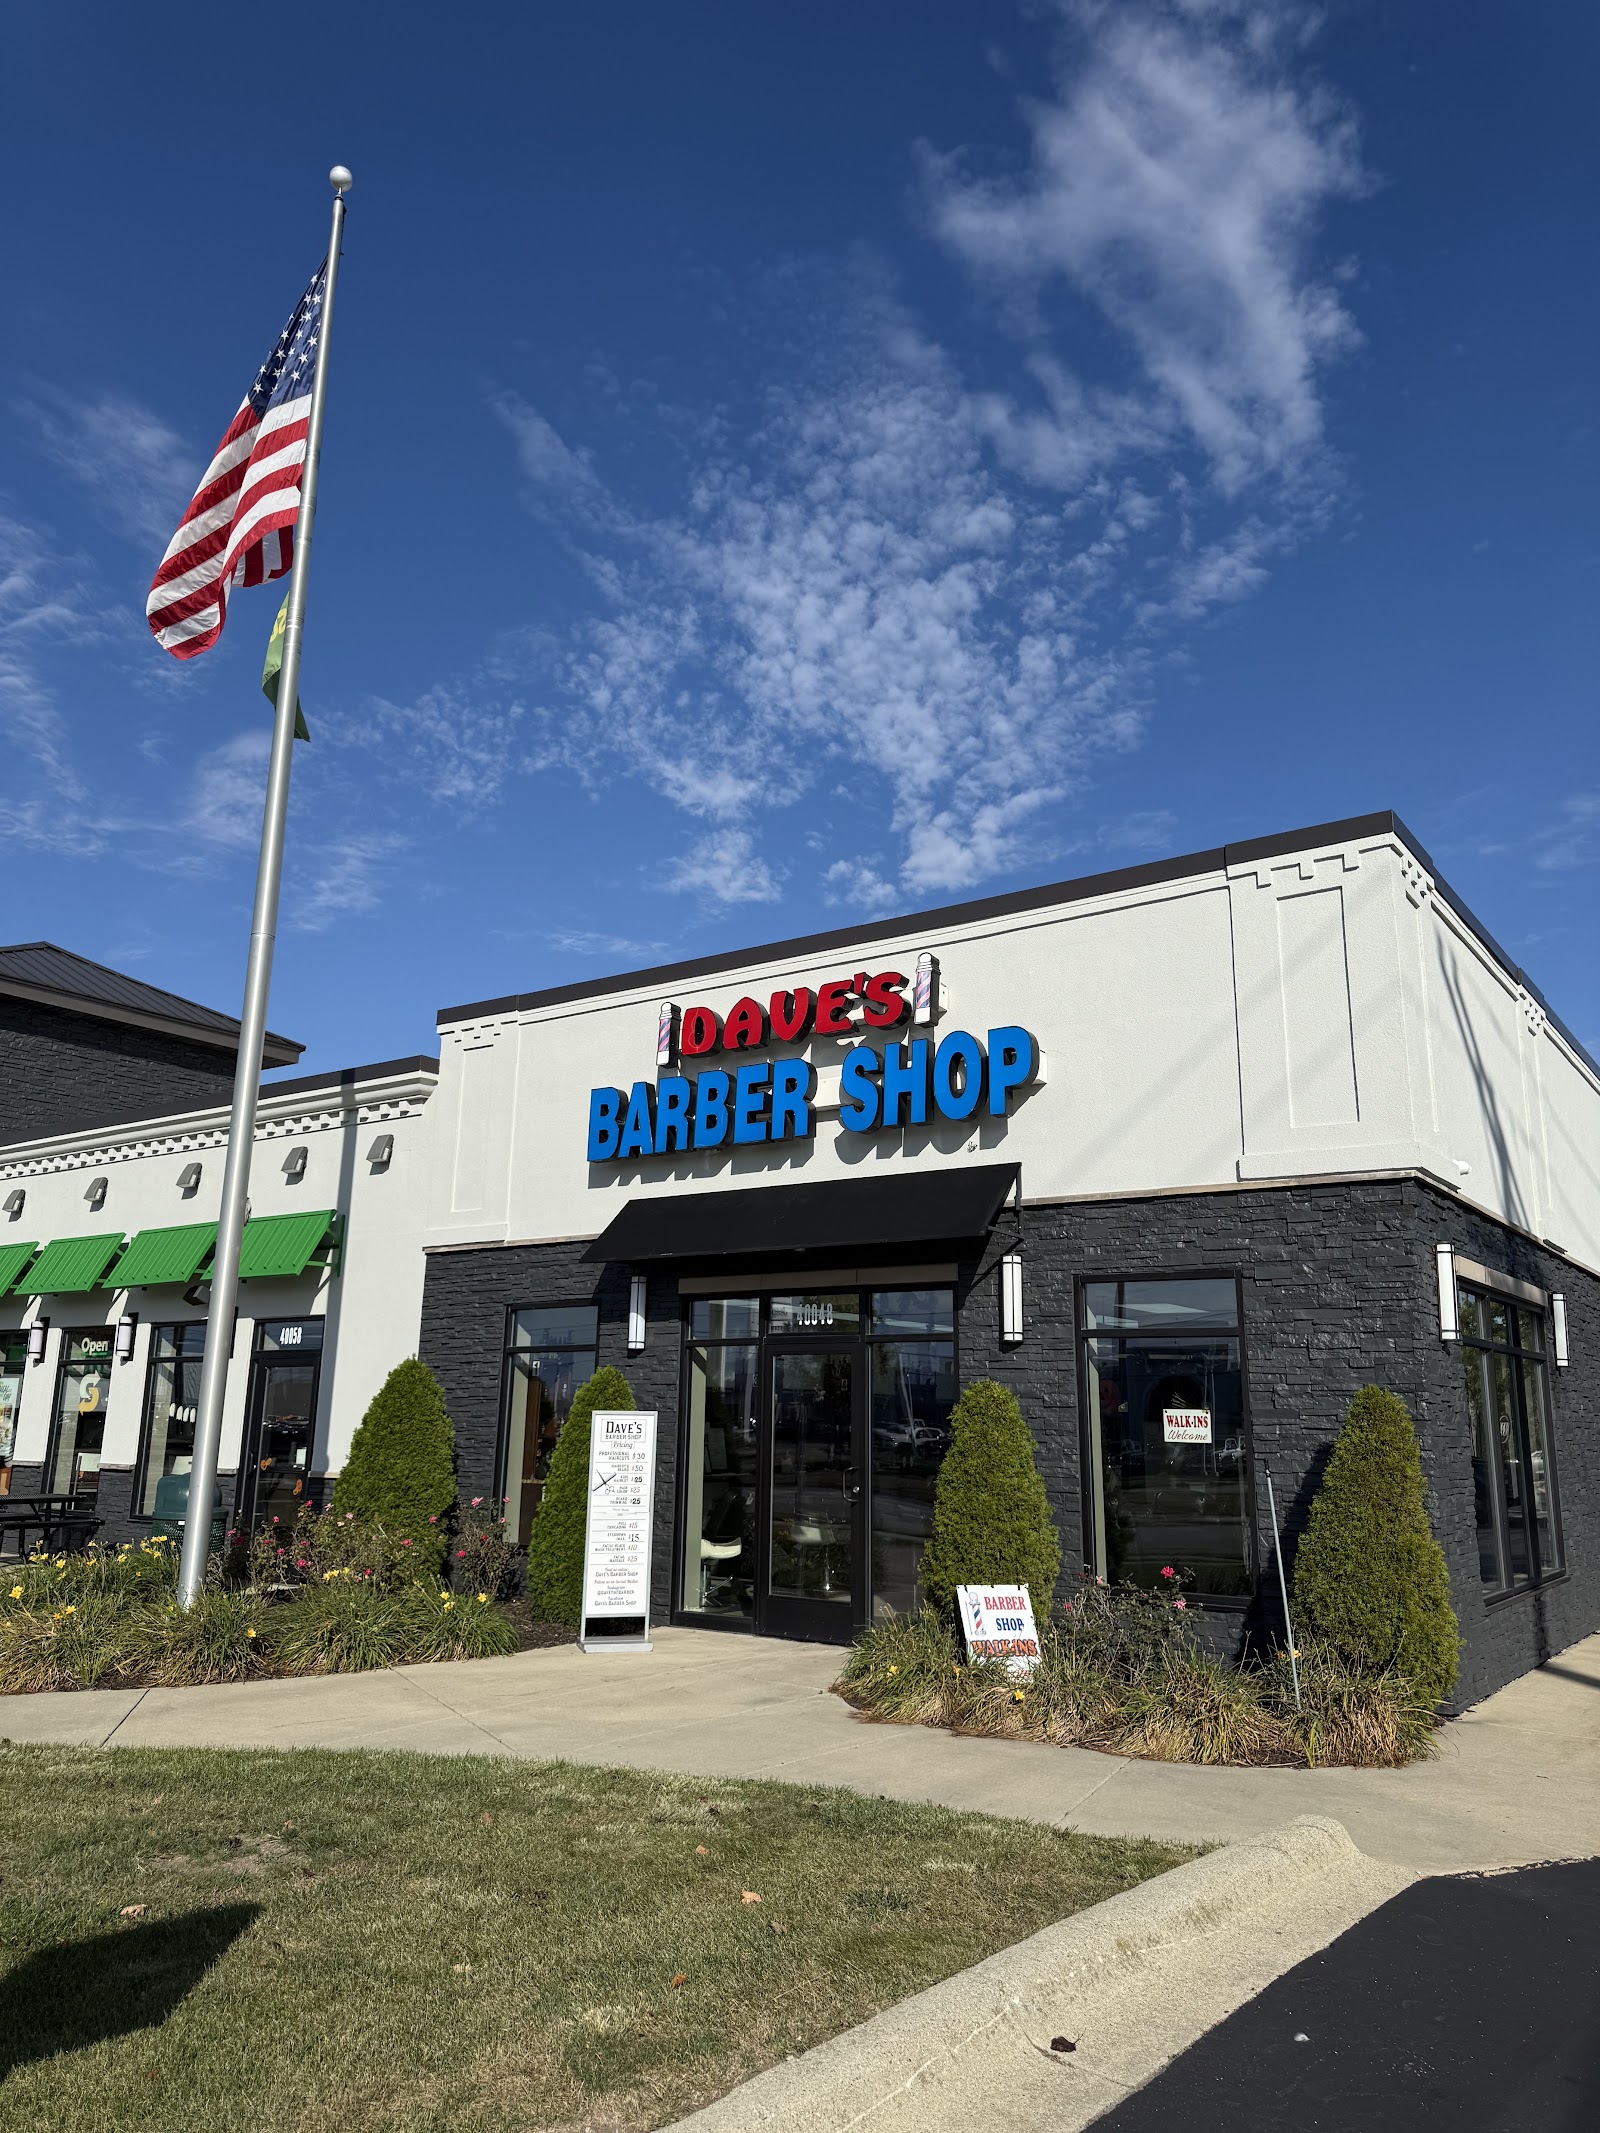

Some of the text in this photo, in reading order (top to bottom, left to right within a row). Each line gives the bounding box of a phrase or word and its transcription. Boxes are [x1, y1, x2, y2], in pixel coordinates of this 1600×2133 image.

[681, 971, 909, 1056] DAVE'S
[587, 1025, 1039, 1162] BARBER SHOP
[796, 1302, 834, 1326] 40048
[279, 1326, 303, 1345] 40058
[81, 1337, 109, 1356] Open
[606, 1421, 642, 1434] DAVE'S
[1167, 1429, 1208, 1441] Welcome
[614, 1440, 633, 1450] Pricing
[628, 1533, 640, 1542] $15
[983, 1596, 1027, 1611] BARBER
[995, 1617, 1025, 1632] SHOP
